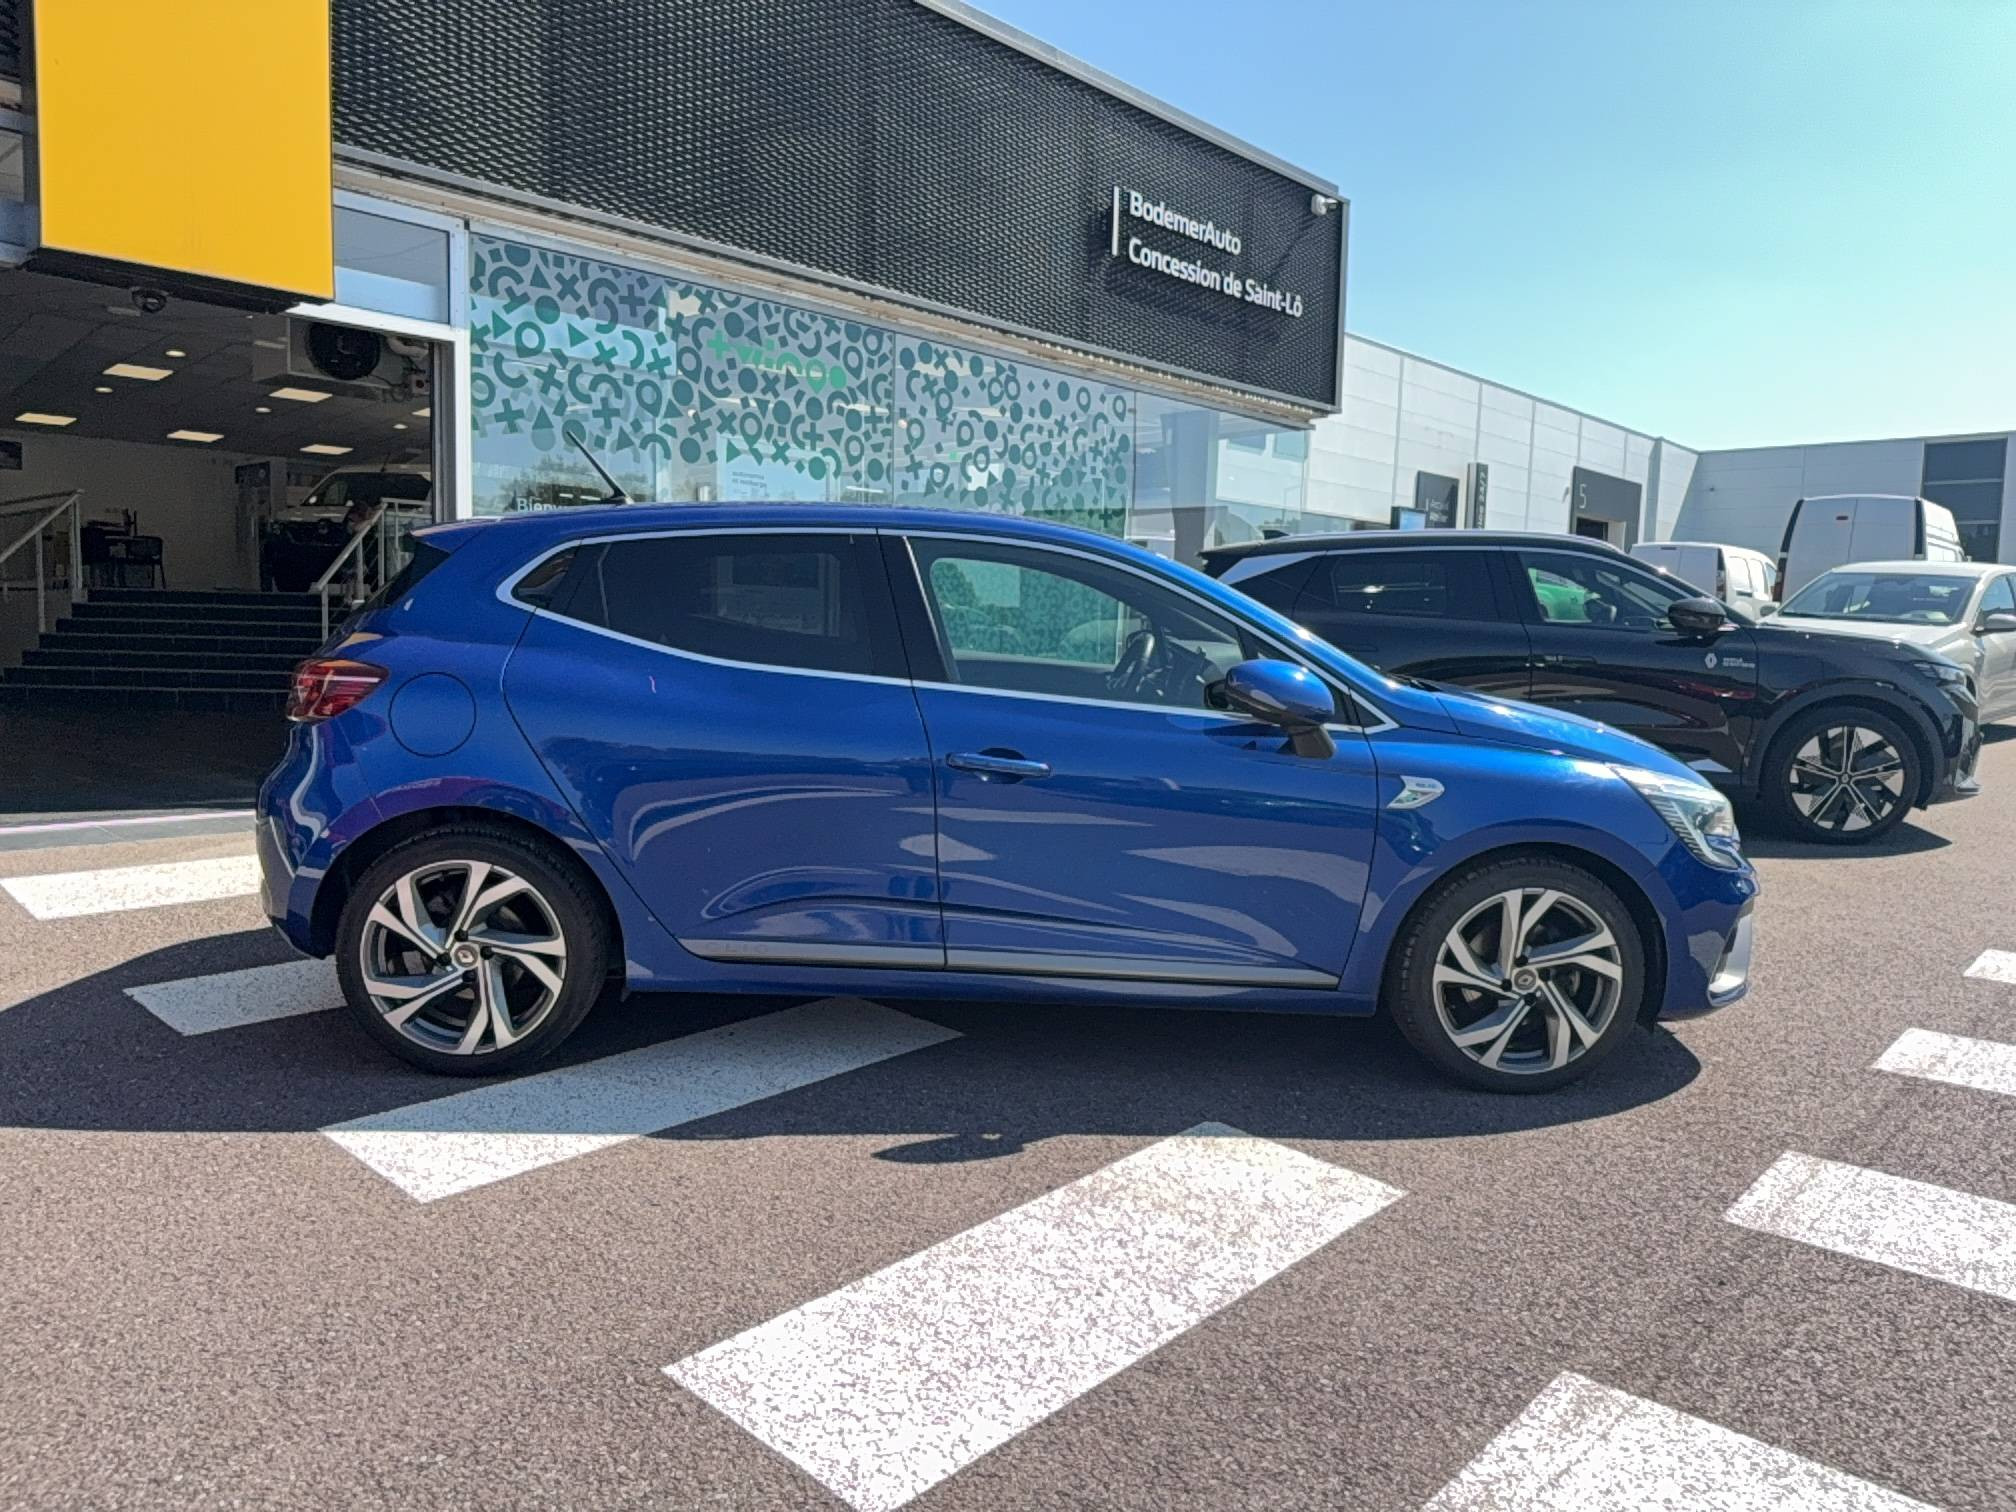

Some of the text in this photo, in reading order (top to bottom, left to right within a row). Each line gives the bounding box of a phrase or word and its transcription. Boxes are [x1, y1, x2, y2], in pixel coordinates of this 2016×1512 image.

[1129, 189, 1242, 255] BodemerAuto
[1128, 237, 1303, 317] Concession de Saint-Lô
